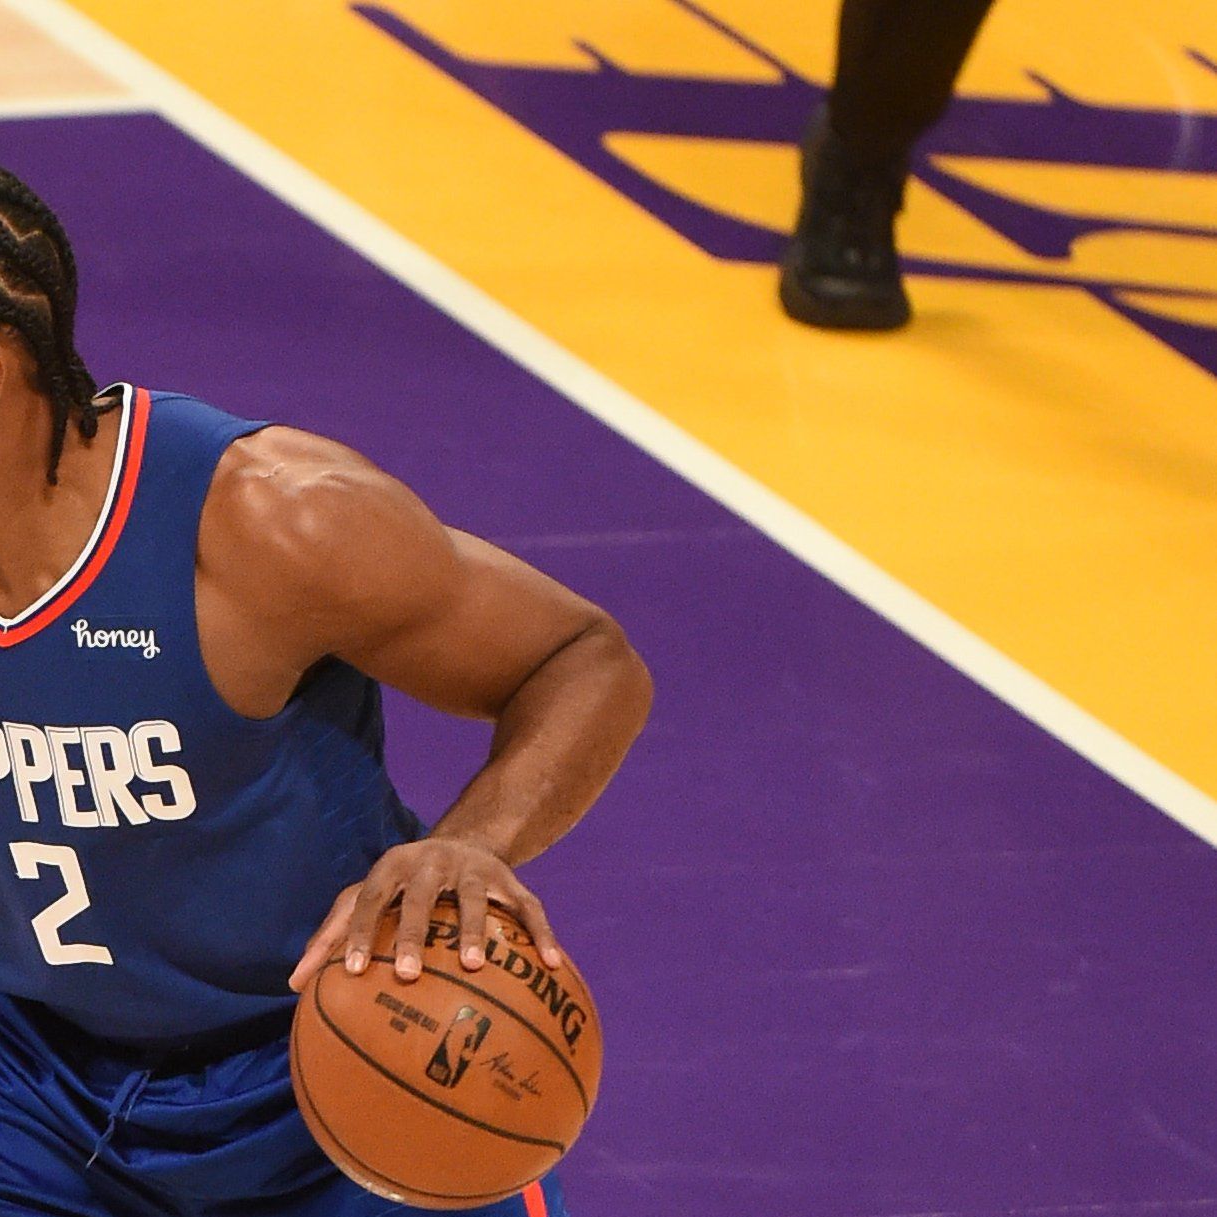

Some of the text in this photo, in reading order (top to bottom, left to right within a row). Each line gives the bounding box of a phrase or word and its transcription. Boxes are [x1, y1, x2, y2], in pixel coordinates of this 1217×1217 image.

[71, 619, 160, 659] honey
[9, 841, 114, 966] 2
[393, 919, 587, 1050] PLDING
